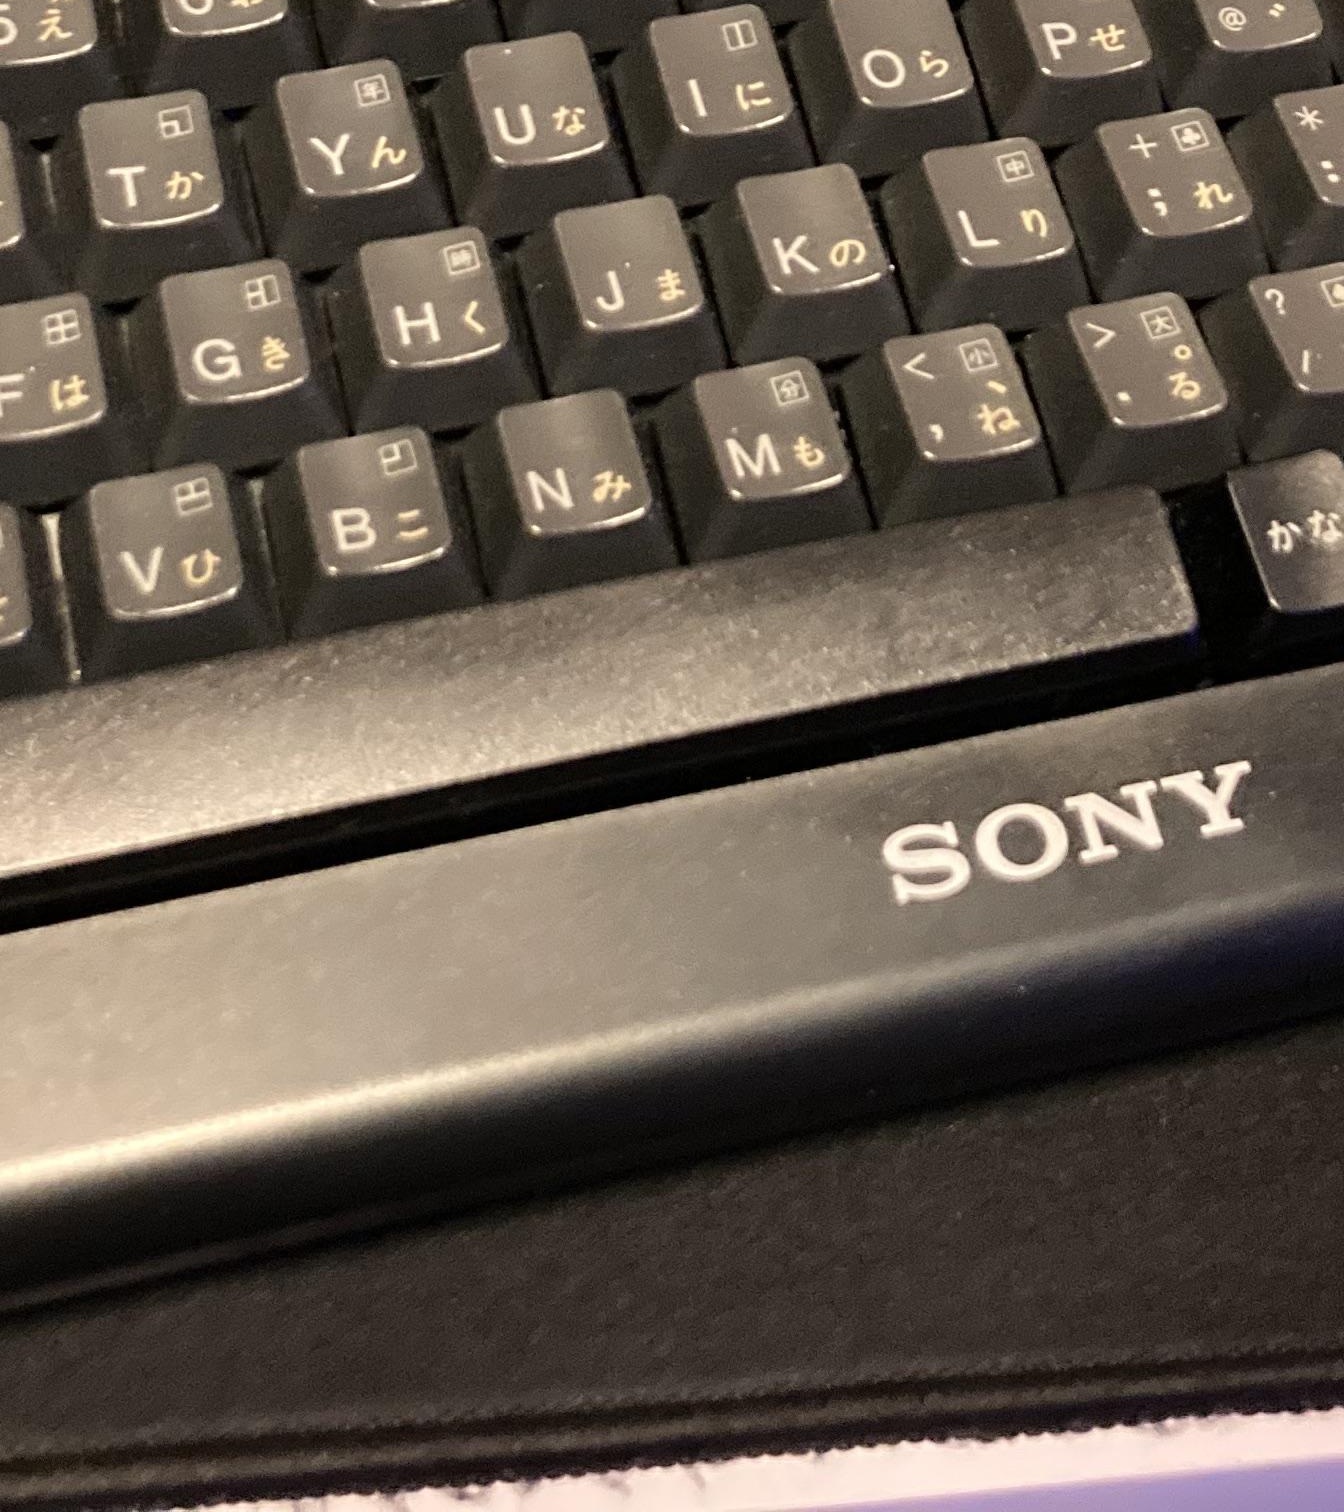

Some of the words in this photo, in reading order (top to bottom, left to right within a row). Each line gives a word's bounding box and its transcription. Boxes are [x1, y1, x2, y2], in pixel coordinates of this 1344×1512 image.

[1042, 23, 1077, 59] P
[863, 50, 905, 88] O
[688, 79, 707, 117] I
[494, 105, 535, 145] U
[310, 133, 350, 175] Y
[107, 166, 146, 207] T
[958, 210, 1000, 247] L
[773, 235, 819, 274] K
[597, 271, 624, 312] J
[394, 302, 440, 345] H
[193, 339, 241, 382] G
[726, 434, 781, 478] M
[527, 468, 574, 511] N
[331, 508, 376, 552] B
[1267, 509, 1342, 553] かな
[121, 547, 163, 594] V
[883, 760, 1252, 906] SONY
